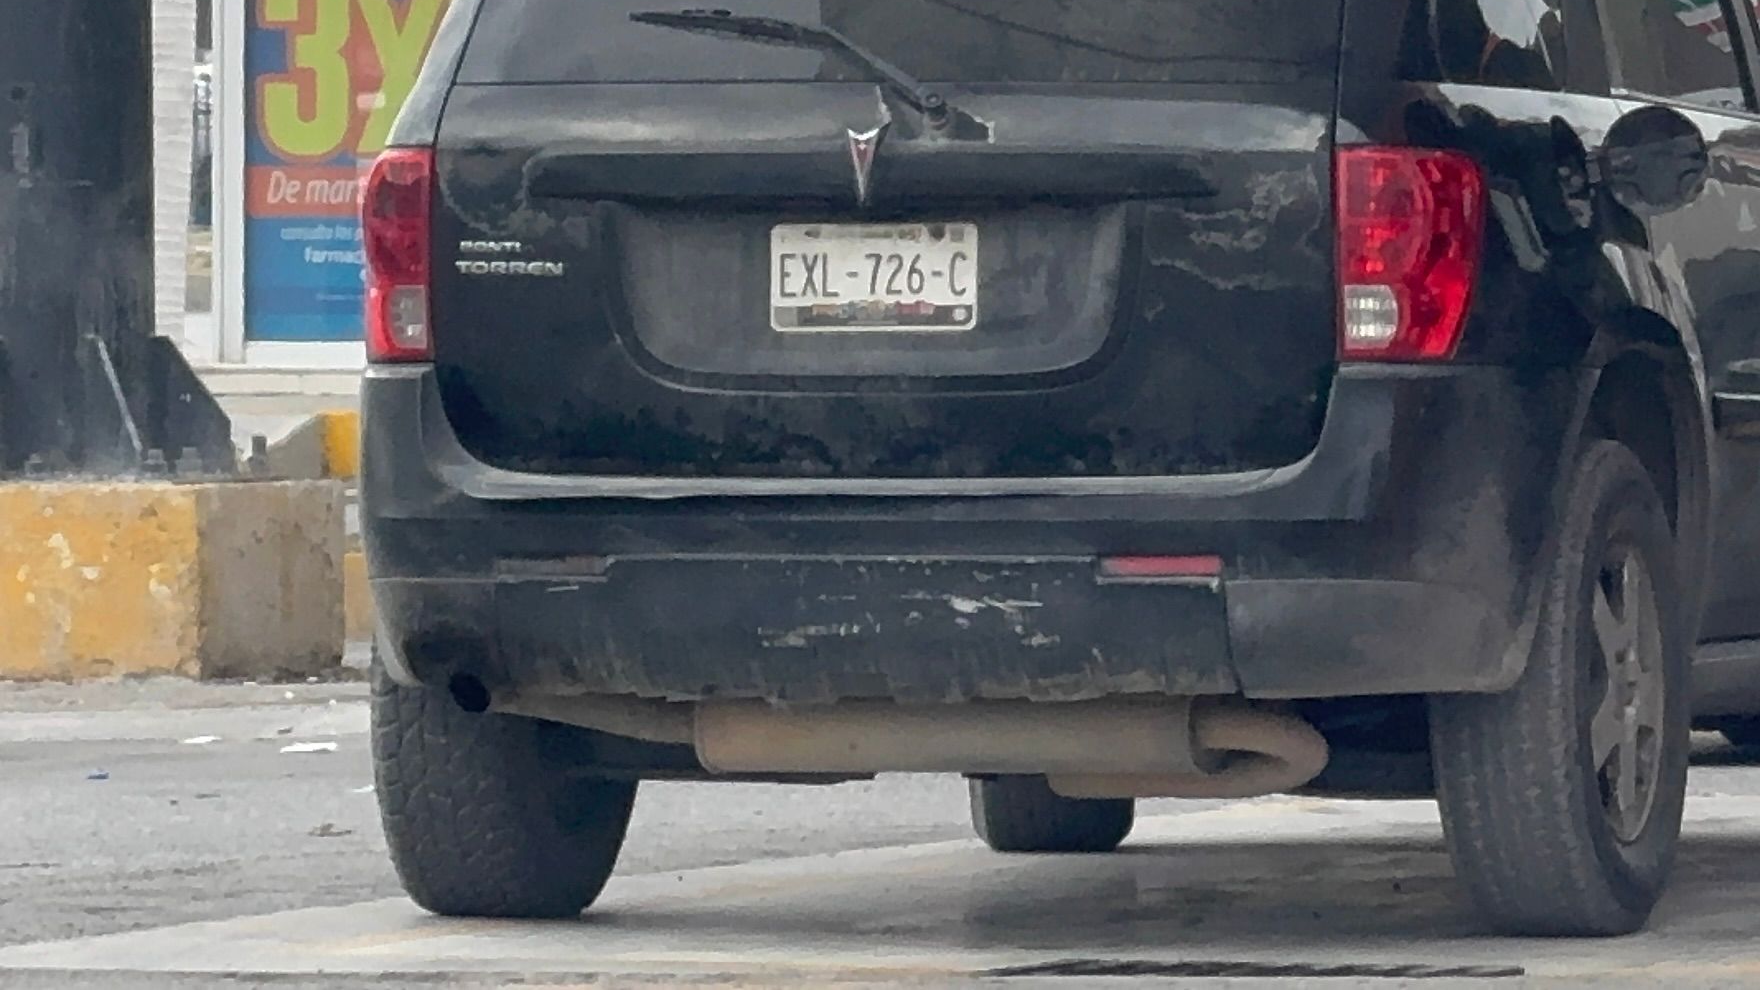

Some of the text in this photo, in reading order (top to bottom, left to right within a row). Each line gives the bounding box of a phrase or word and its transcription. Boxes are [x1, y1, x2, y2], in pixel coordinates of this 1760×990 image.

[267, 170, 364, 204] De mar
[779, 250, 968, 298] EXL-726-C
